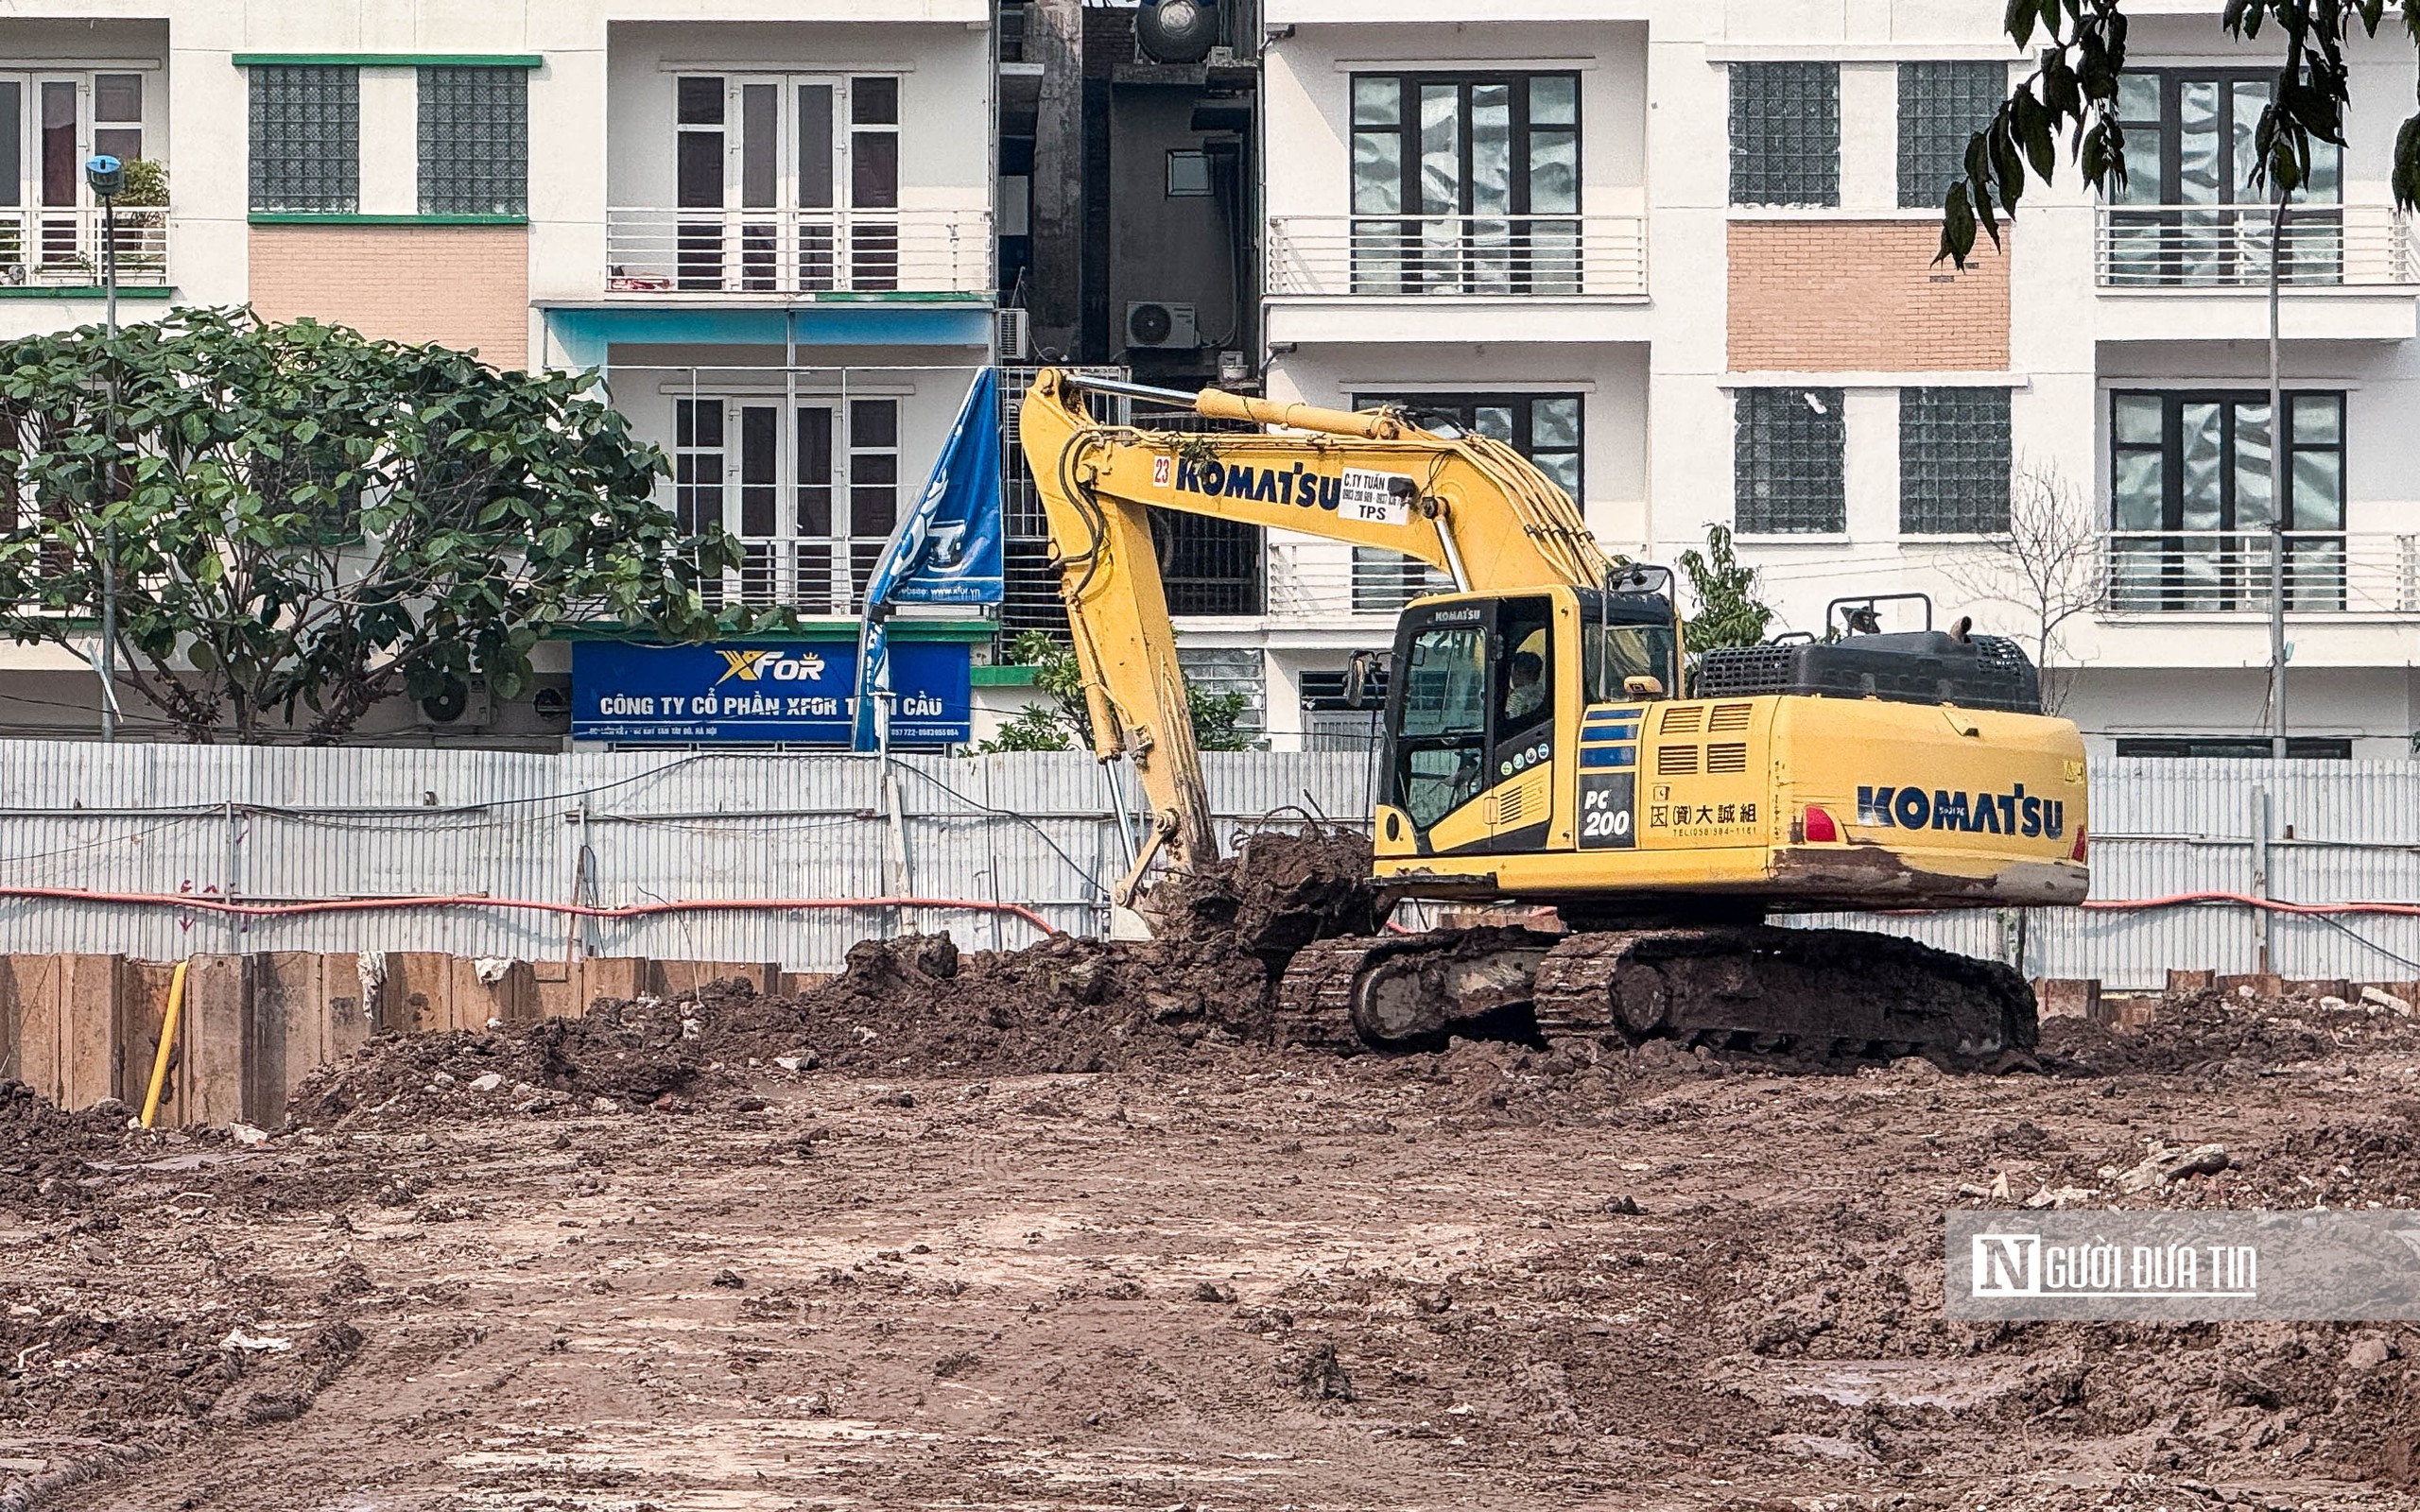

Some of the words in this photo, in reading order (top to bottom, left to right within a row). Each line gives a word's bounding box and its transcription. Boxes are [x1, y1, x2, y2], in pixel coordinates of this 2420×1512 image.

[1155, 458, 1169, 484] 23
[1175, 456, 1342, 511] KOMATSU
[1359, 505, 1386, 521] TPS
[1435, 608, 1480, 622] KOMATSU
[600, 692, 654, 715] CÔNG
[661, 697, 684, 714] TY
[692, 687, 717, 715] CỔ
[724, 689, 780, 715] PHẦN
[787, 697, 838, 715] XFOR
[903, 690, 942, 716] CẦU
[1584, 790, 1610, 809] PC
[1857, 783, 2063, 839] KOMATSU
[1584, 810, 1630, 836] 200
